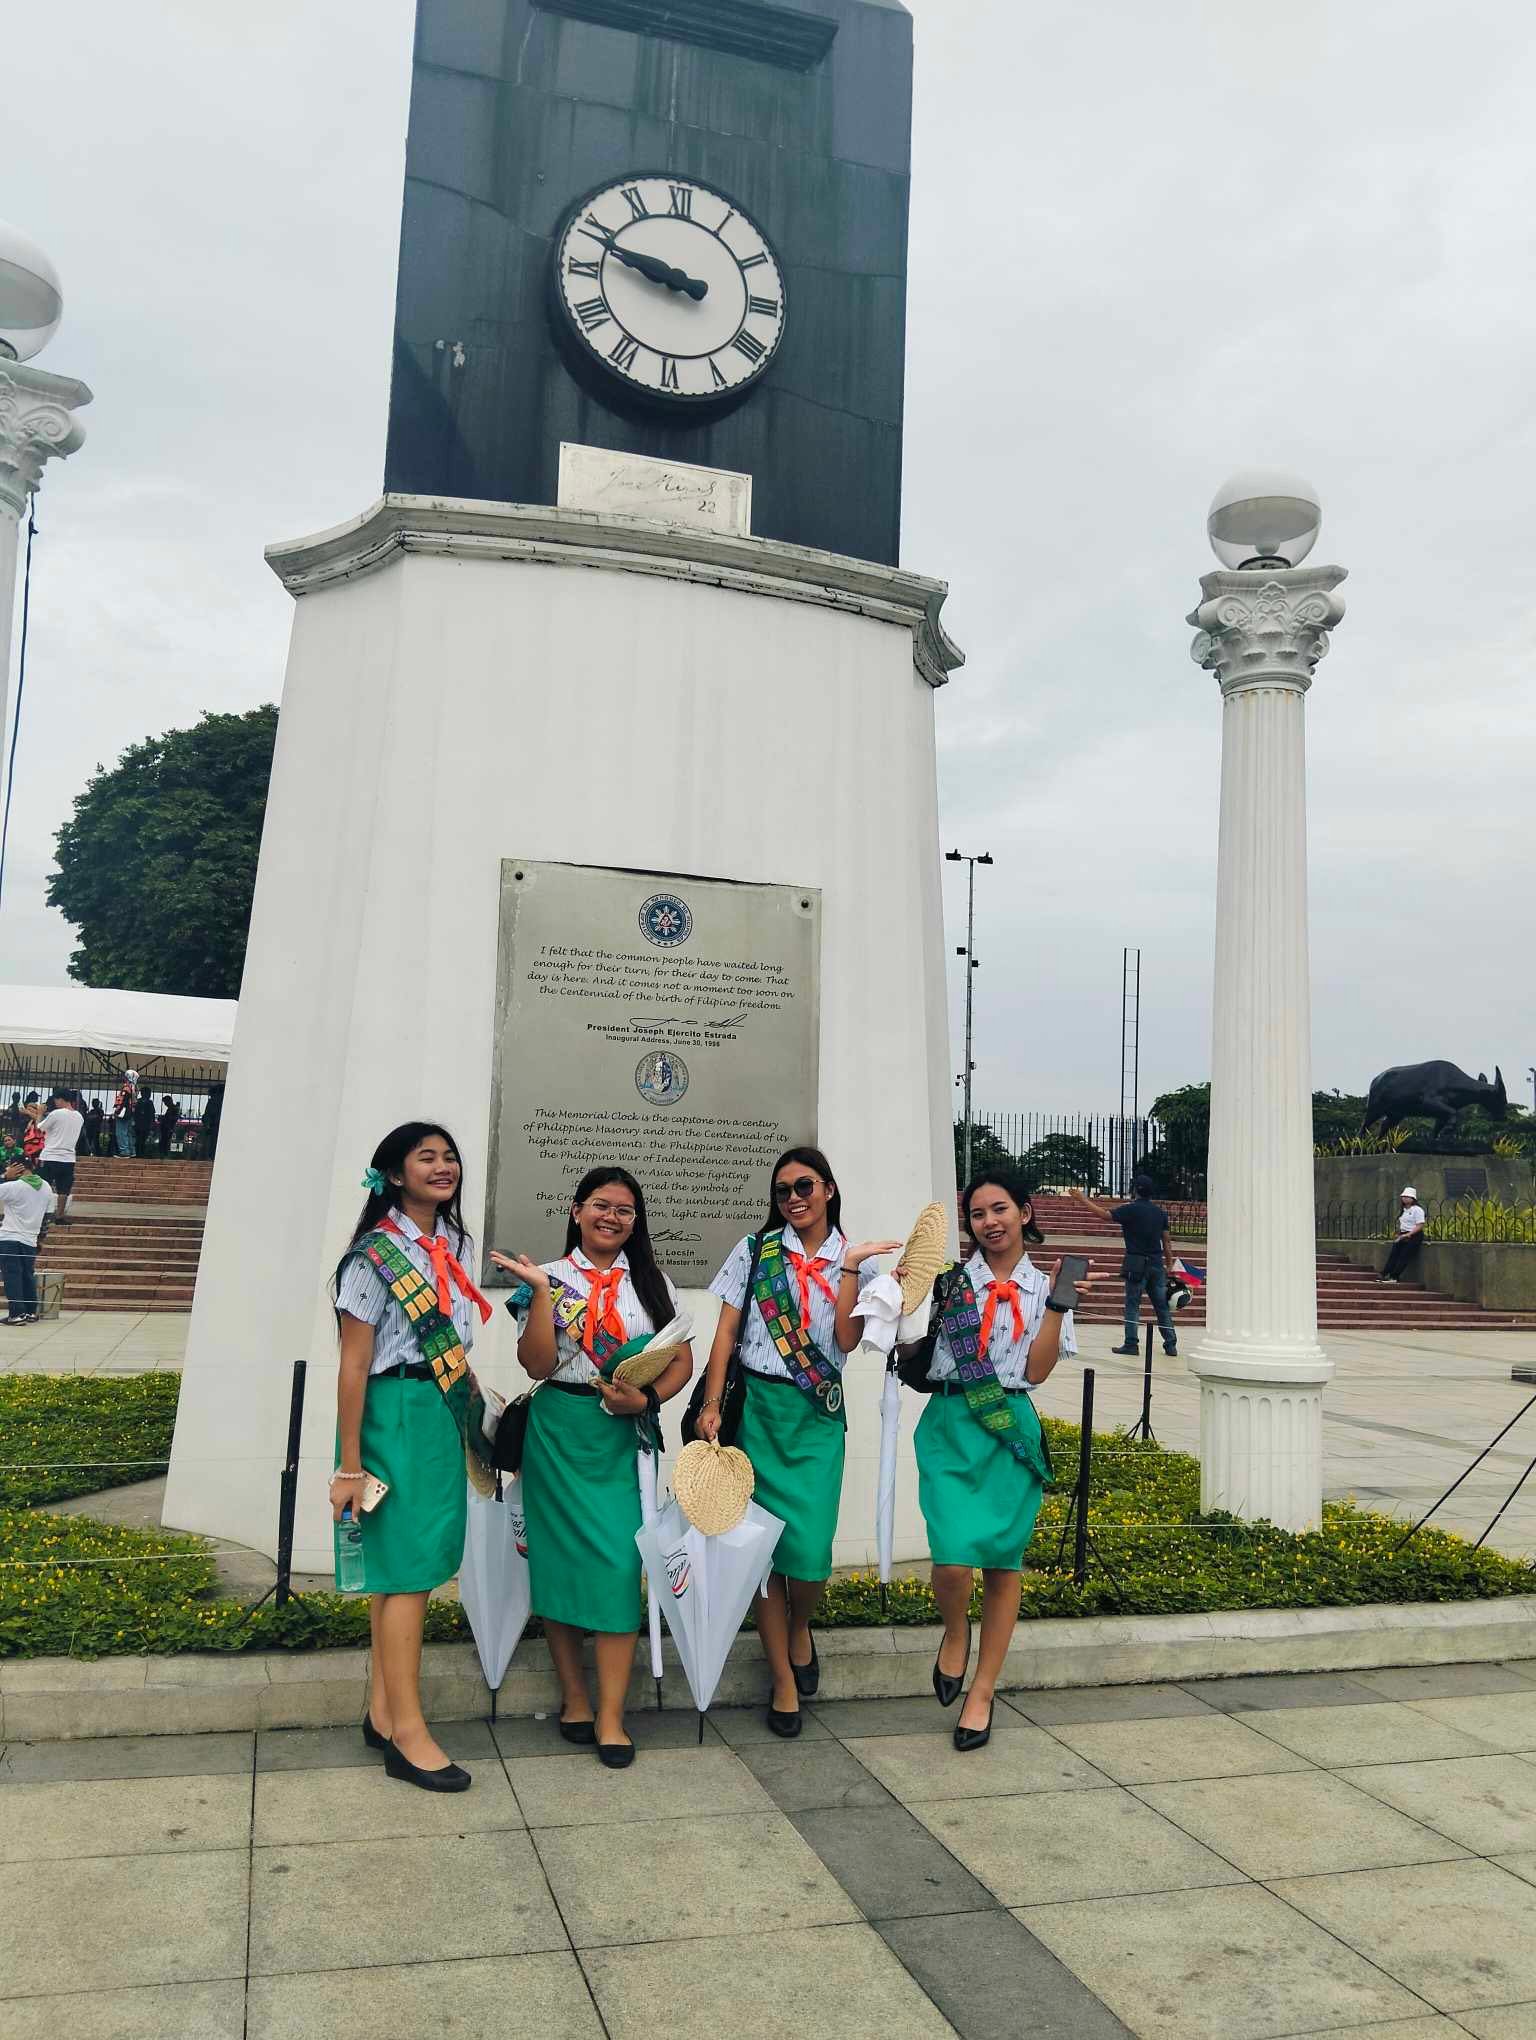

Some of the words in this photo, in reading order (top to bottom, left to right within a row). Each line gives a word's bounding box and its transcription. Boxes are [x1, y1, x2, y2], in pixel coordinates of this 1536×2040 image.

[621, 186, 650, 222] XI
[669, 185, 693, 220] XII
[568, 256, 600, 280] IX
[737, 251, 769, 272] II
[573, 296, 612, 334] VIII
[749, 294, 779, 318] III
[608, 334, 640, 372] VII
[731, 328, 768, 365] IIII
[660, 357, 680, 390] VI
[708, 357, 727, 387] V
[540, 946, 547, 954] I
[549, 946, 568, 956] felt
[570, 947, 594, 958] that
[596, 950, 614, 958] the
[616, 954, 660, 962] common
[661, 956, 695, 967] people
[697, 958, 721, 968] have
[724, 961, 759, 970] waited
[760, 962, 784, 974] long
[527, 971, 548, 982] day
[551, 974, 562, 982] is
[592, 976, 615, 986] And
[618, 978, 628, 986] it
[629, 980, 661, 989] comes
[663, 982, 682, 990] not
[694, 984, 736, 994] moment
[736, 986, 754, 994] too
[533, 960, 575, 971] enough
[577, 962, 592, 971] for
[595, 962, 622, 972] their
[654, 968, 670, 977] for
[672, 968, 698, 978] their
[700, 970, 720, 982] day
[721, 973, 732, 981] to
[765, 976, 790, 985] That
[539, 985, 558, 994] the
[560, 986, 620, 999] Centennial
[622, 992, 635, 1001] of
[636, 992, 654, 1001] the
[655, 993, 682, 1002] birth
[684, 996, 696, 1005] of
[696, 996, 738, 1008] Filipino
[586, 1024, 630, 1033] President
[633, 1026, 664, 1036] Joseph
[667, 1029, 701, 1038] Ejercito
[704, 1032, 738, 1040] Estrada
[605, 1034, 639, 1043] Inaugural
[640, 1036, 672, 1046] Address,
[674, 1038, 691, 1046] June
[536, 1108, 558, 1118] This
[558, 1109, 610, 1120] Memorial
[611, 1111, 640, 1121] Clock
[642, 1114, 650, 1122] is
[652, 1114, 670, 1122] the
[671, 1116, 714, 1126] capstone
[716, 1118, 732, 1126] on
[732, 1119, 740, 1127] a
[742, 1120, 780, 1130] century
[522, 1121, 536, 1132] of
[536, 1122, 593, 1135] Philippine
[596, 1124, 640, 1136] Masonry
[643, 1126, 666, 1136] and
[668, 1129, 682, 1137] on
[685, 1128, 702, 1138] the
[704, 1129, 762, 1141] Centennial
[763, 1132, 775, 1142] of
[776, 1134, 790, 1143] its
[528, 1136, 570, 1148] highest
[650, 1140, 668, 1150] the
[669, 1141, 724, 1153] Philippine
[539, 1150, 560, 1159] the
[560, 1150, 616, 1163] Philippine
[618, 1152, 641, 1161] War
[642, 1153, 656, 1162] of
[656, 1154, 730, 1166] Independence
[731, 1158, 754, 1167] and
[755, 1158, 774, 1167] the
[562, 1164, 584, 1176] first
[634, 1168, 648, 1177] in
[648, 1168, 674, 1178] Asia
[675, 1168, 706, 1178] whose
[707, 1170, 750, 1182] fighting
[536, 1191, 556, 1201] the
[665, 1194, 682, 1204] the
[684, 1196, 730, 1207] sunburst
[732, 1198, 754, 1207] and
[671, 1182, 688, 1192] the
[691, 1184, 730, 1194] symbols
[732, 1184, 744, 1194] of
[671, 1208, 699, 1220] light
[700, 1210, 723, 1219] and
[666, 1248, 695, 1256] Locsin
